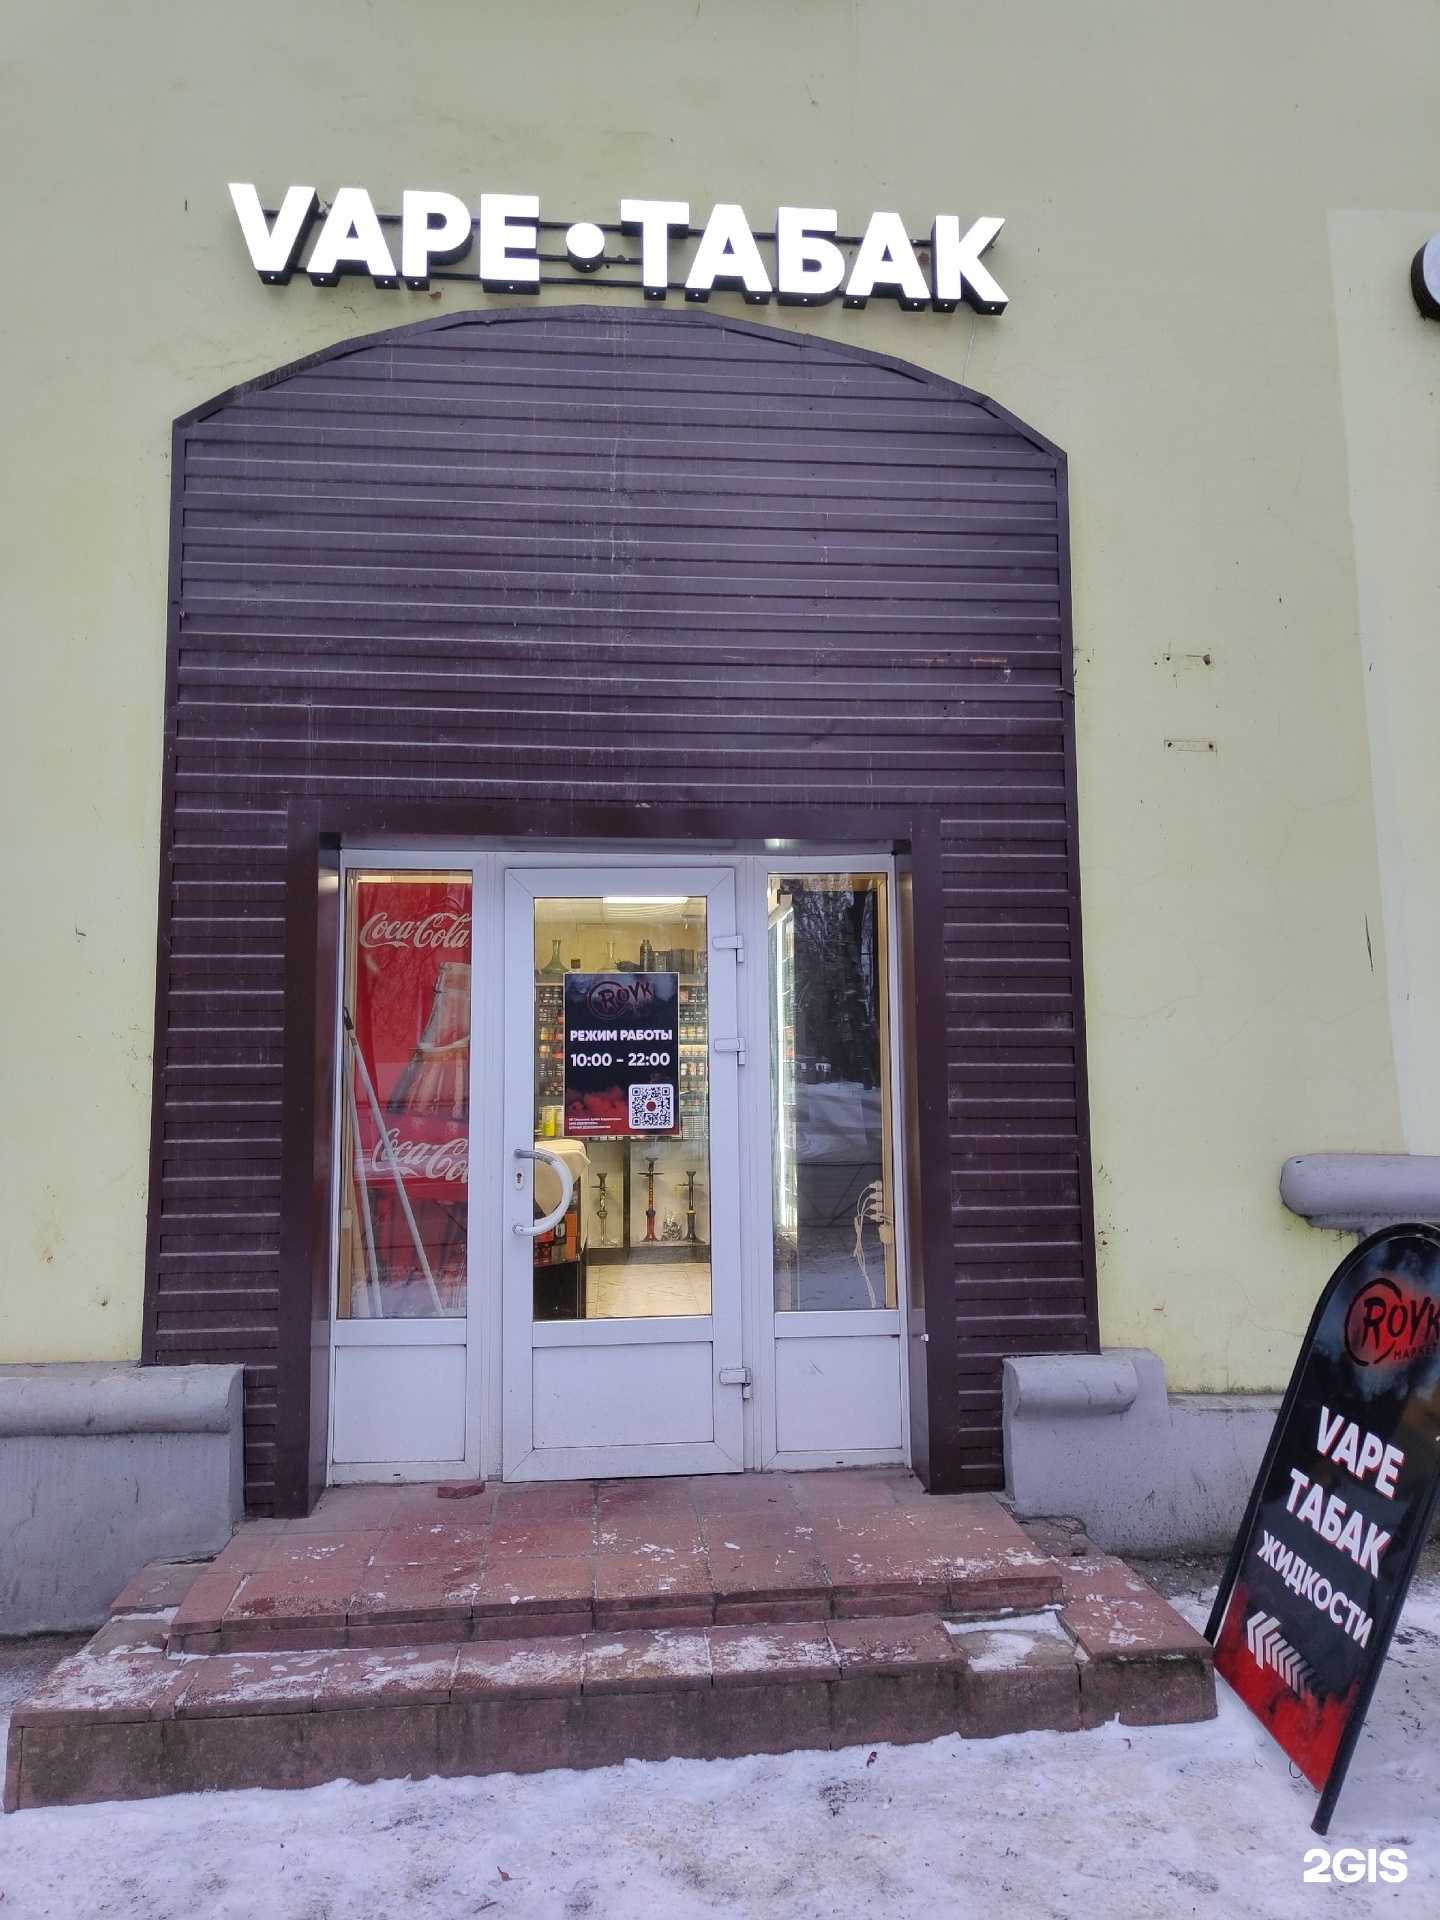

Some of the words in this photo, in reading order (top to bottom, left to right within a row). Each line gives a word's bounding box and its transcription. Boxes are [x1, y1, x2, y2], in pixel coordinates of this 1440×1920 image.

[228, 182, 541, 290] VAPE
[619, 198, 1010, 313] ТАБАК
[360, 911, 472, 949] Coca-Cola
[569, 1030, 618, 1042] РЕЖИМ
[620, 1029, 673, 1041] РАБОТЫ
[570, 1052, 612, 1067] 10:00
[627, 1052, 671, 1067] 22:00
[1316, 1405, 1405, 1500] VAPE
[1286, 1467, 1393, 1579] ТАБАК
[1256, 1529, 1375, 1649] ЖИДКОСТИ
